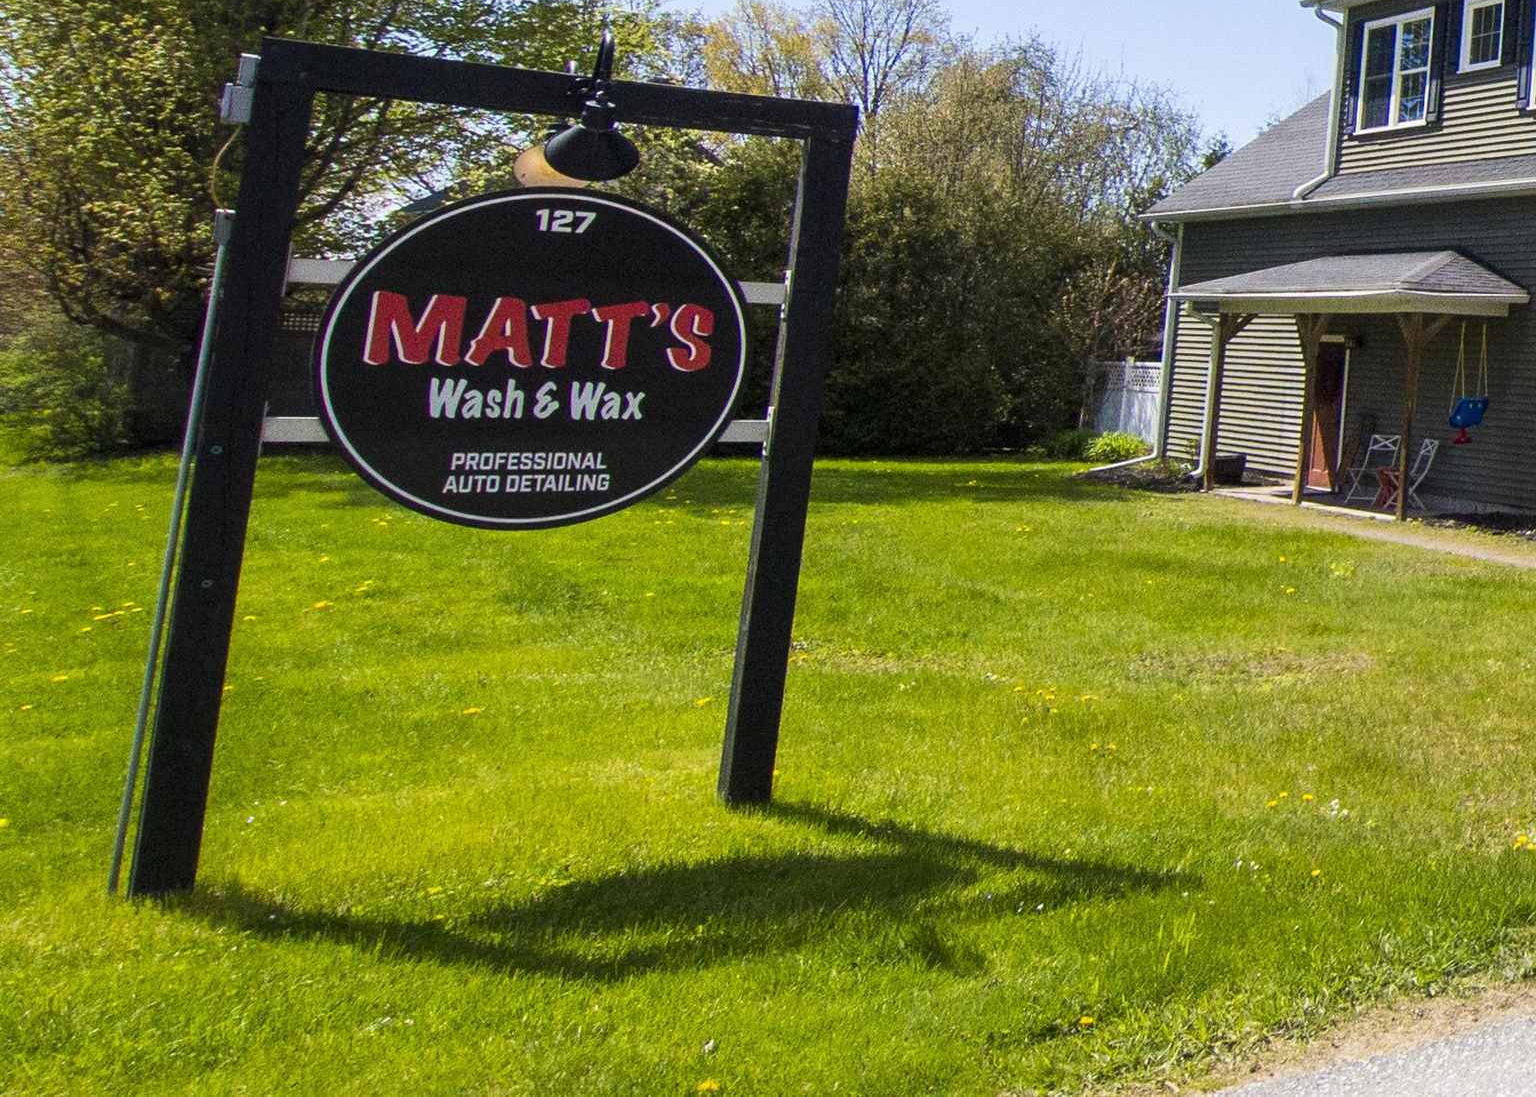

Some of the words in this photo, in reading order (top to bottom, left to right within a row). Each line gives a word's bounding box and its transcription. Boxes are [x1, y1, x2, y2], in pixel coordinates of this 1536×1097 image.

[535, 209, 597, 234] 127
[364, 290, 714, 372] MATT'S
[429, 377, 524, 419] Wash
[533, 381, 560, 418] &
[570, 382, 646, 420] Wax
[450, 452, 607, 471] PROFESSIONAL
[442, 474, 501, 493] AUTO
[505, 473, 610, 491] DETAILING
